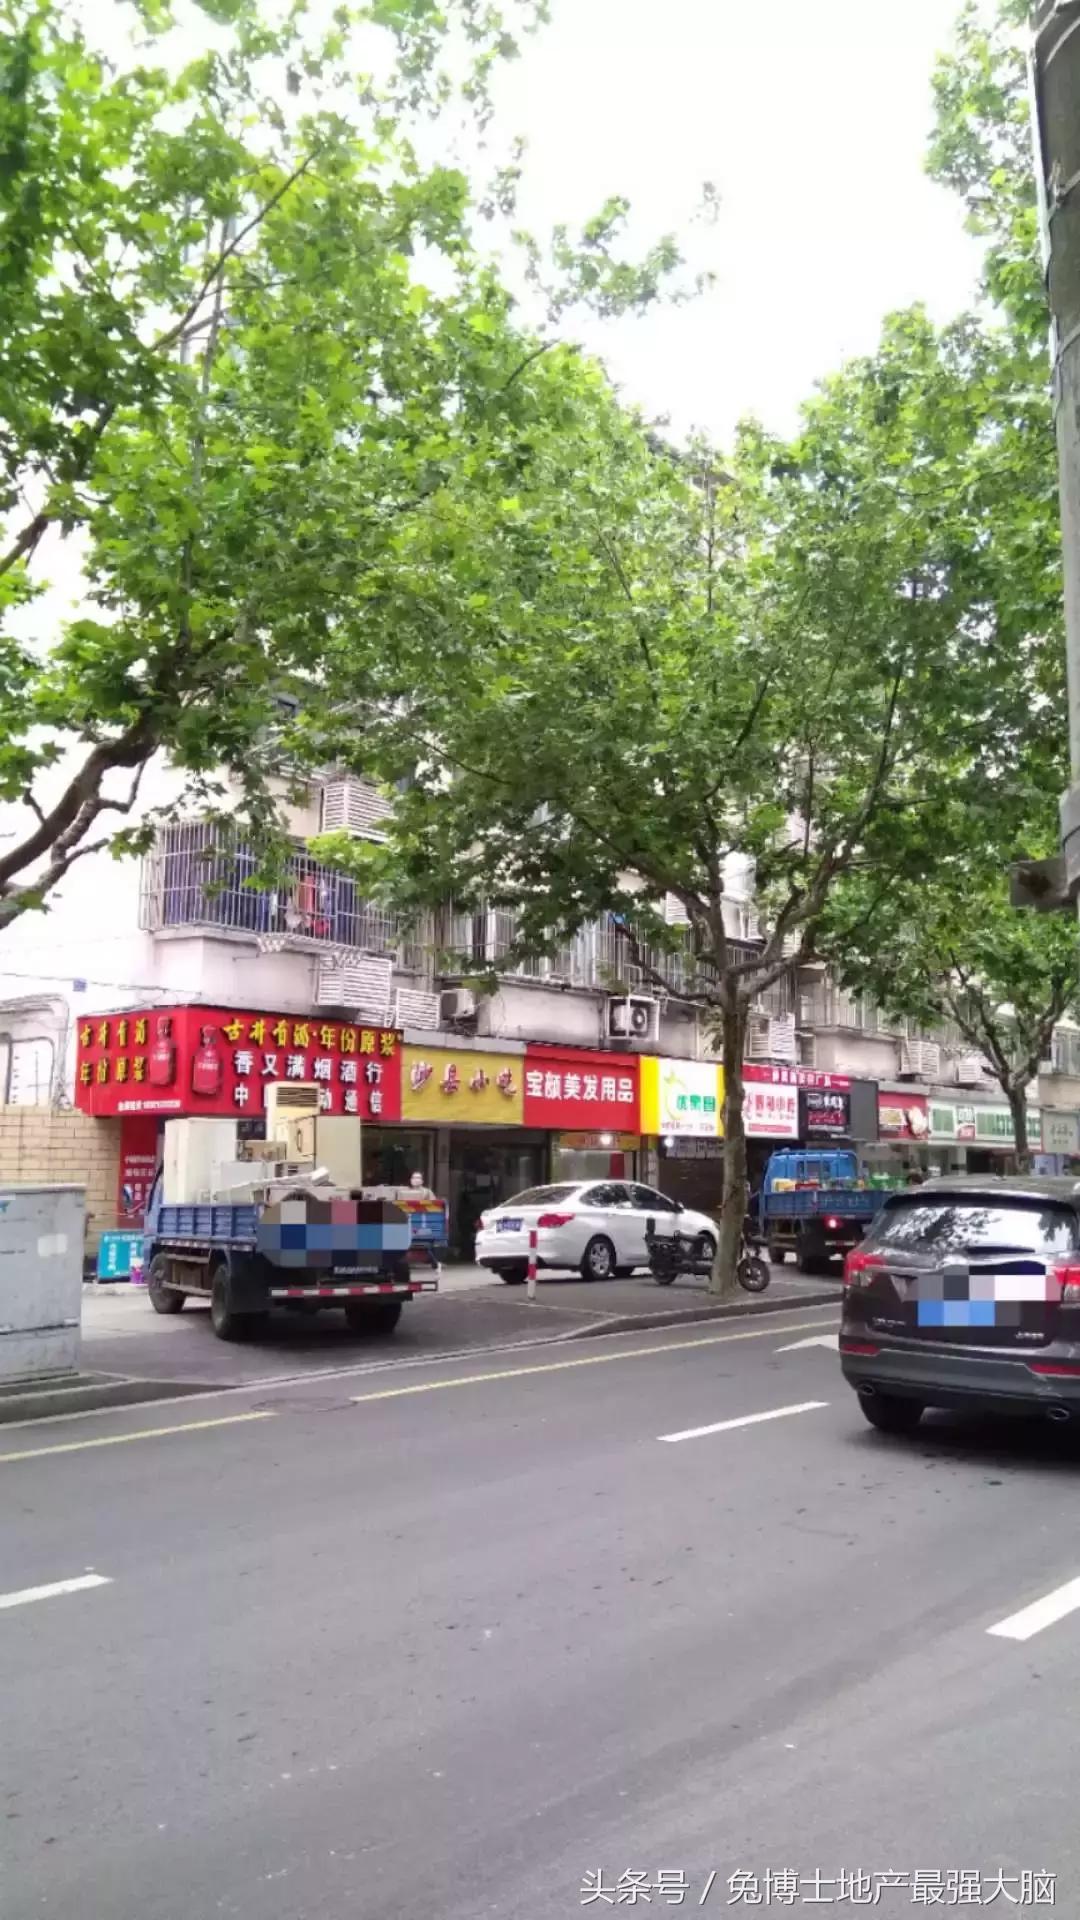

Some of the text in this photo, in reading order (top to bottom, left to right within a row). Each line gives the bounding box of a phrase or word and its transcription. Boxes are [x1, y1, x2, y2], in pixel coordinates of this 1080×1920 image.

[234, 1050, 384, 1084] 香又满烟酒行
[410, 1060, 518, 1097] 沙县小吃
[234, 1081, 384, 1114] 中动通信
